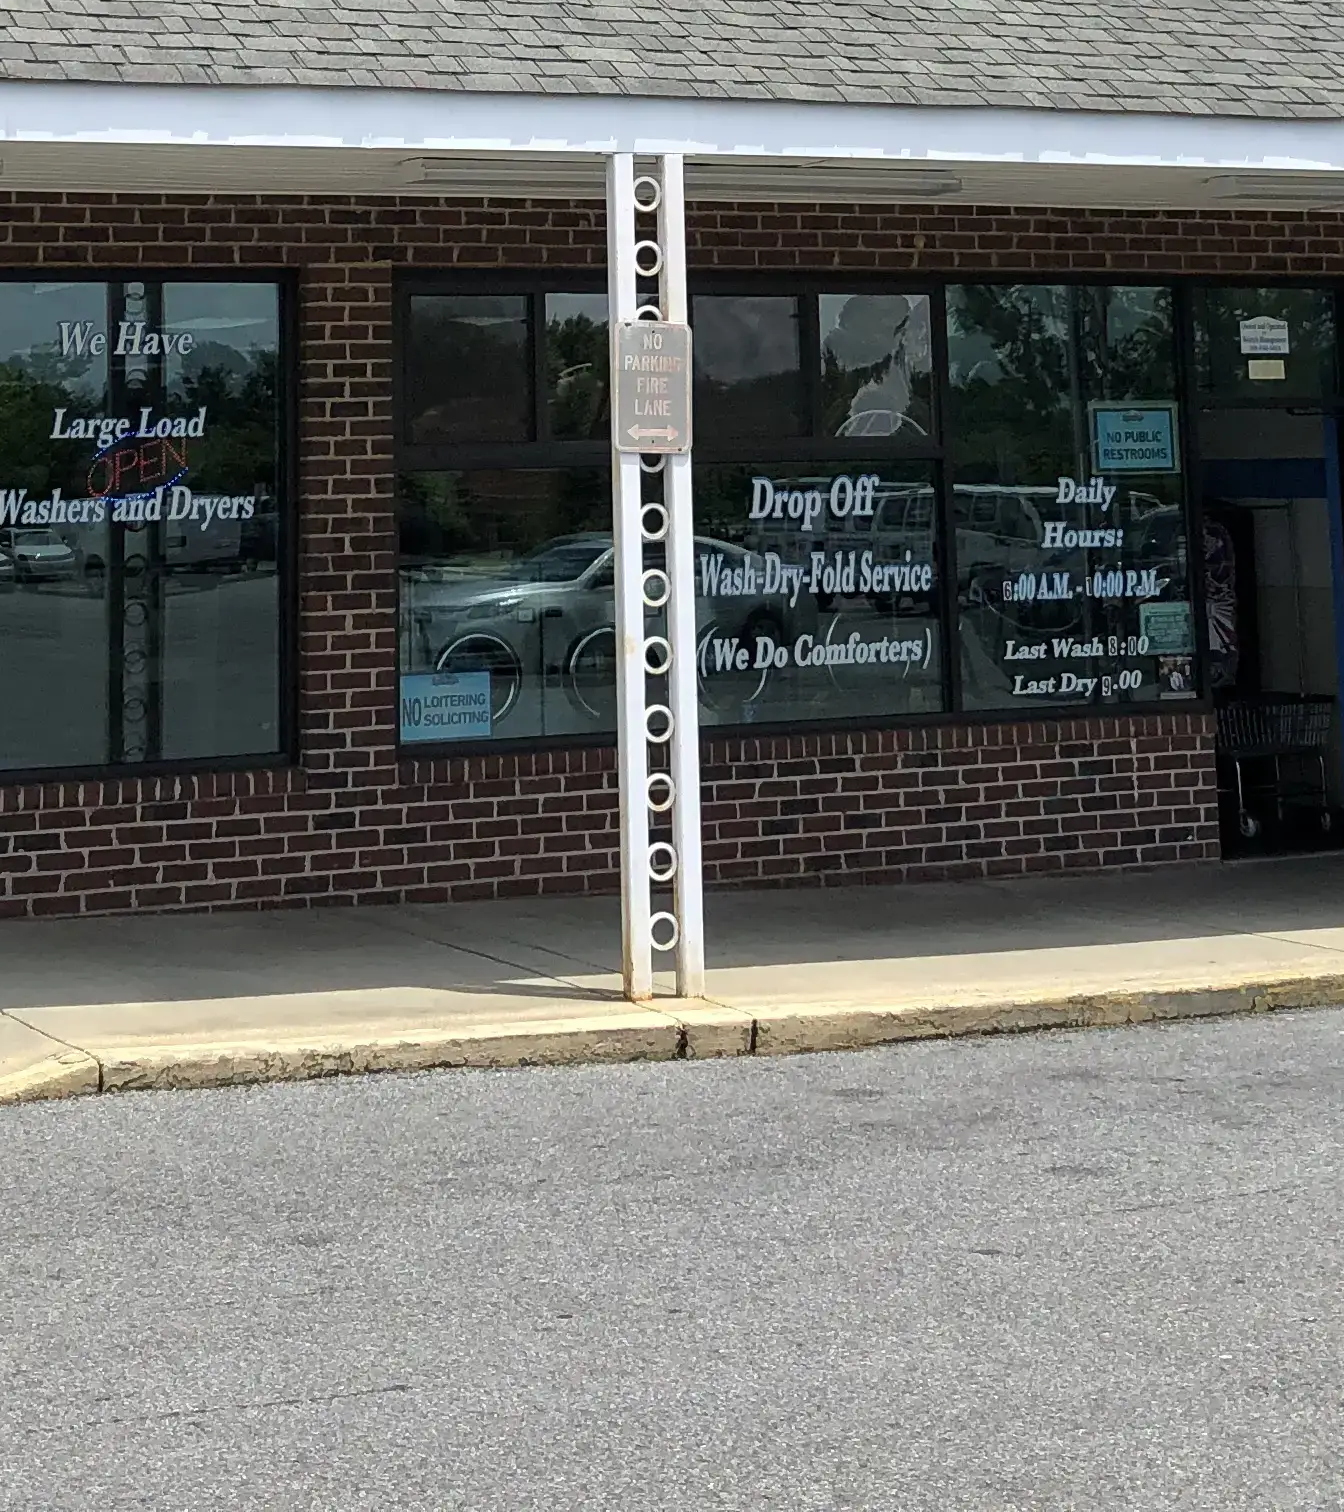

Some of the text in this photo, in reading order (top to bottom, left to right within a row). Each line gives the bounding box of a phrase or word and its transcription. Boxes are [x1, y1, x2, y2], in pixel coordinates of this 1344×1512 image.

[60, 320, 193, 356] We Have
[643, 333, 663, 350] NO
[624, 355, 681, 372] PARKING
[637, 377, 668, 394] FIRE
[634, 399, 672, 416] LANE
[49, 406, 207, 449] Large Load
[1106, 430, 1162, 444] NO PUBLIC
[86, 437, 187, 498] OPEN
[1103, 448, 1167, 461] RESTROOMS
[748, 473, 880, 531] Drop Off
[1056, 476, 1116, 512] Daily
[112, 485, 164, 523] and
[167, 485, 256, 532] Dryers
[1041, 521, 1124, 549] Hours:
[699, 550, 932, 608] Wash-Dry-Fold Service
[754, 636, 788, 669] Do
[794, 627, 932, 670] Comforters)
[1004, 635, 1149, 660] Last Wash 8:00
[1012, 675, 1056, 695] Last
[1058, 672, 1098, 696] Dry
[402, 693, 486, 727] NO LOITERING
[423, 710, 489, 727] SOLICITING
